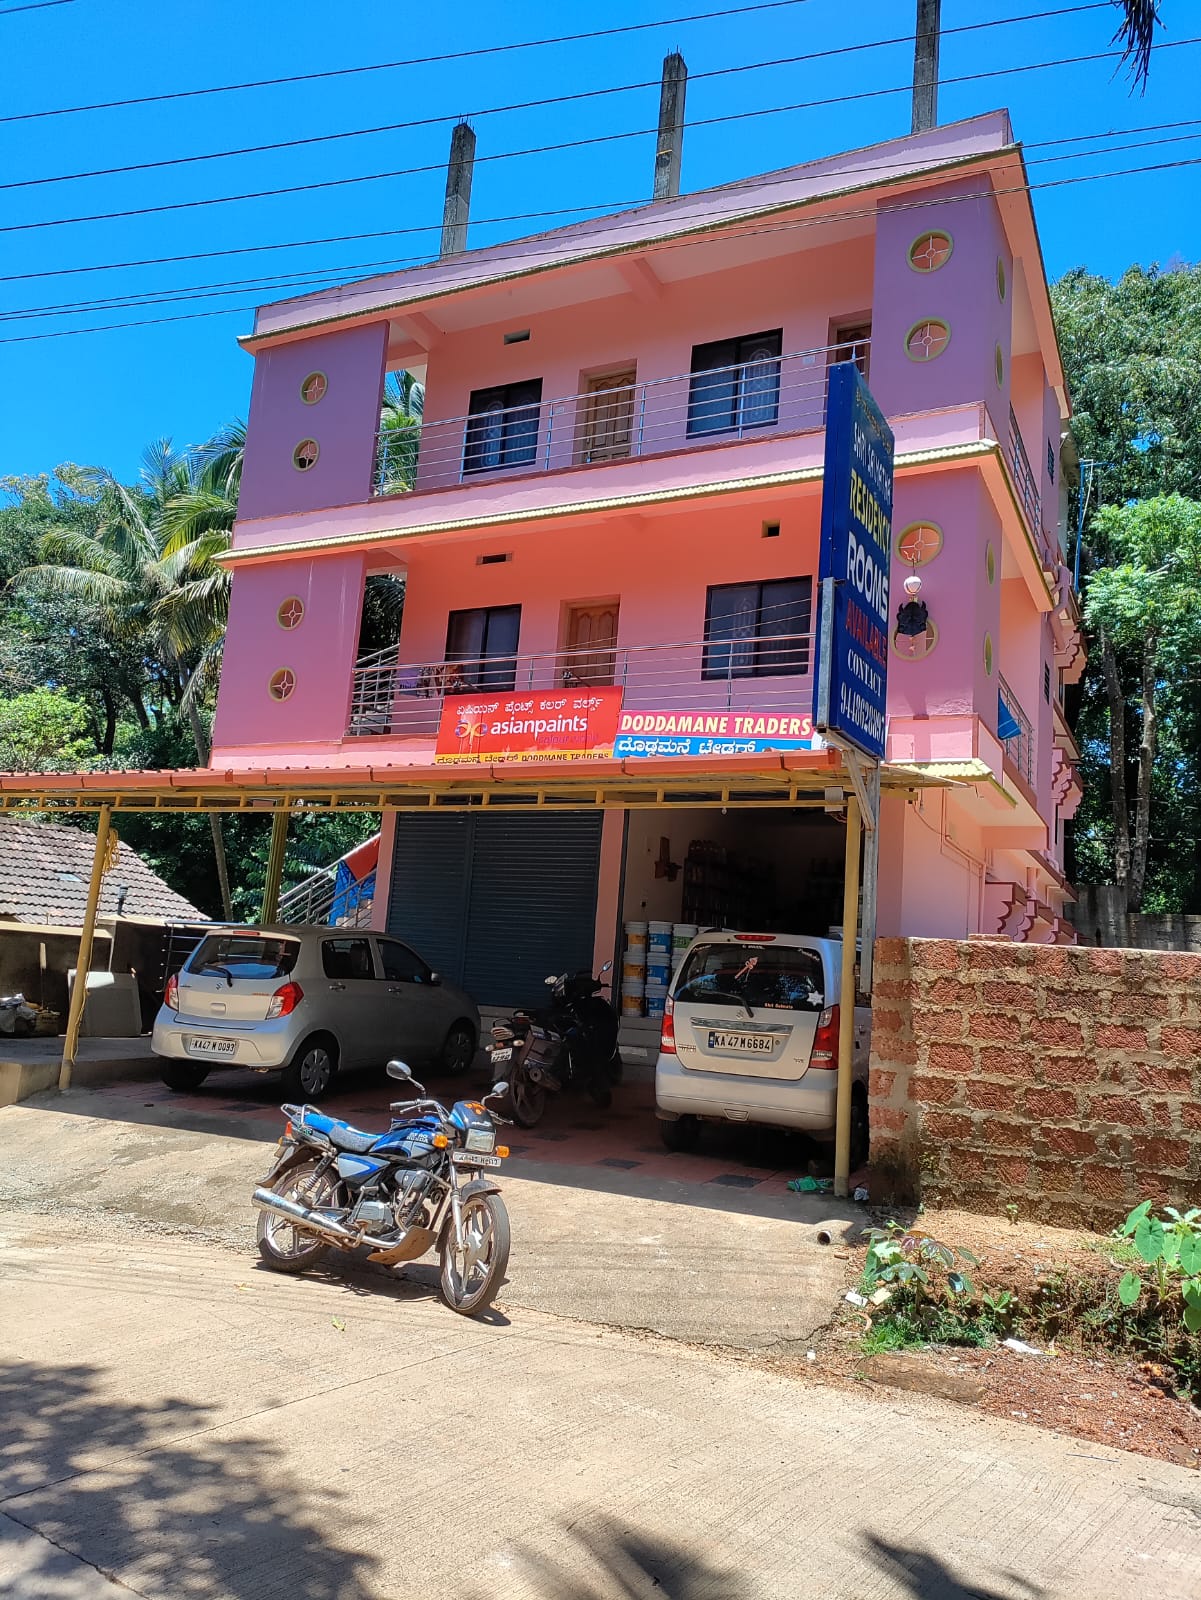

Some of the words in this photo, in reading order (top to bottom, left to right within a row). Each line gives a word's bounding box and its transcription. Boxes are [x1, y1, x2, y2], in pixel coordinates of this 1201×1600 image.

[849, 467, 890, 562] RESIDENCY
[847, 530, 888, 623] ROOMS
[845, 598, 887, 669] AVAILABLE
[847, 648, 882, 697] CONTACT
[490, 714, 588, 741] asianpaints
[540, 698, 568, 710] ಕಲರ್
[620, 715, 728, 733] DODDAMANE
[734, 717, 812, 735] TRADERS
